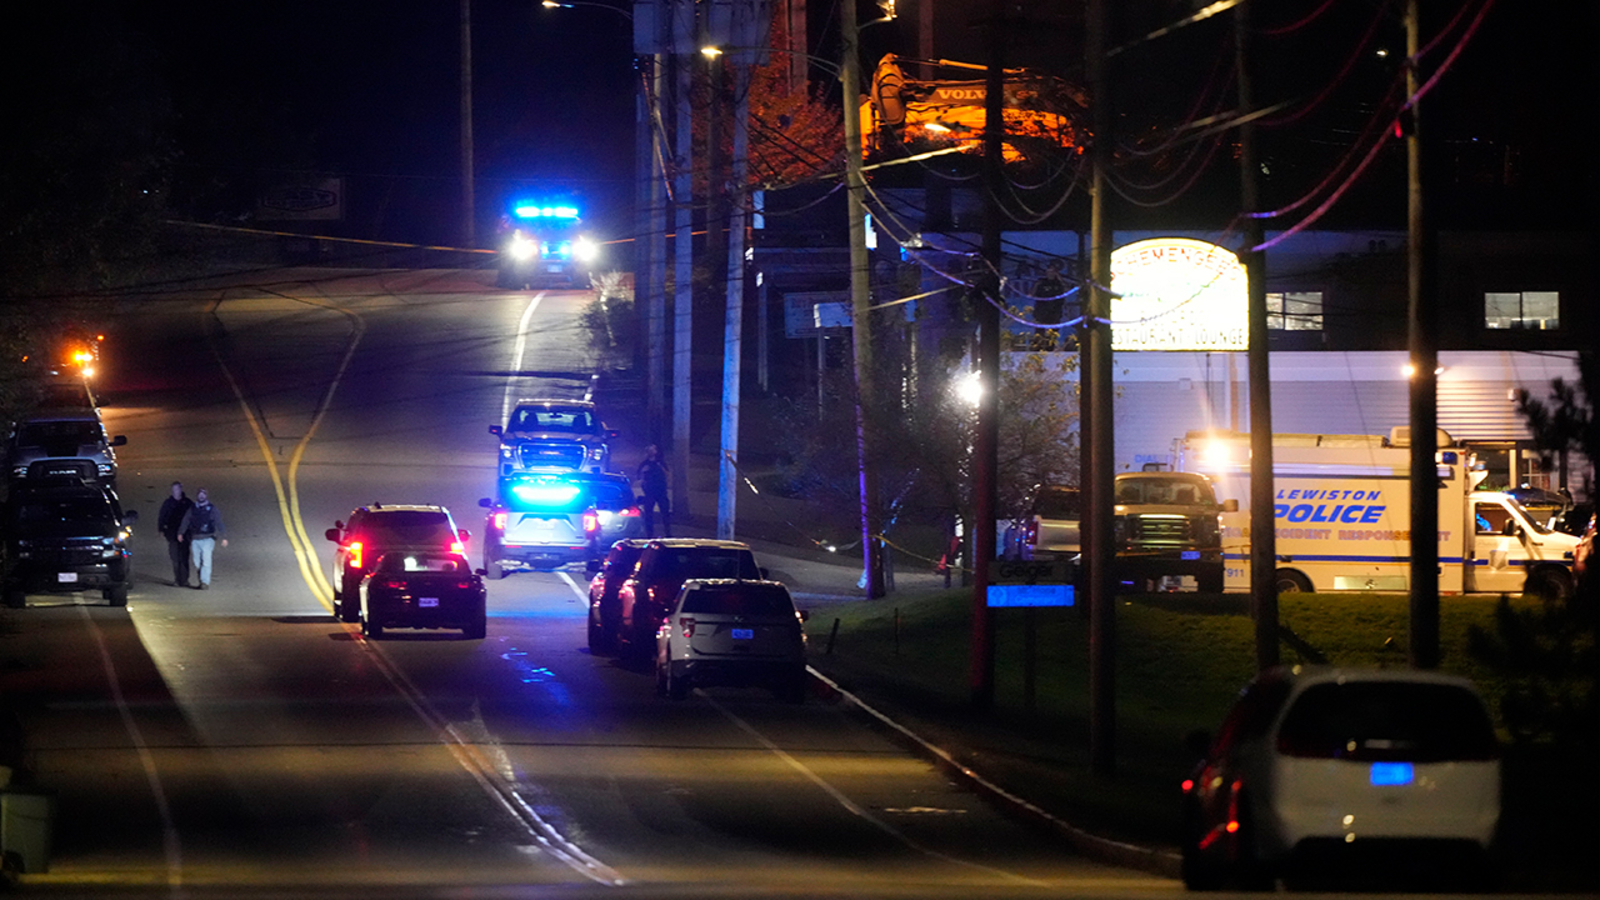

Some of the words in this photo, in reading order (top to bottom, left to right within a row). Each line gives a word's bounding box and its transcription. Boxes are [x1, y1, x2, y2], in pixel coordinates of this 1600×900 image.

[936, 89, 987, 100] VOLV
[1194, 328, 1243, 345] LOUNGE
[1276, 489, 1381, 501] LEWISTON
[1274, 503, 1386, 524] POLICE
